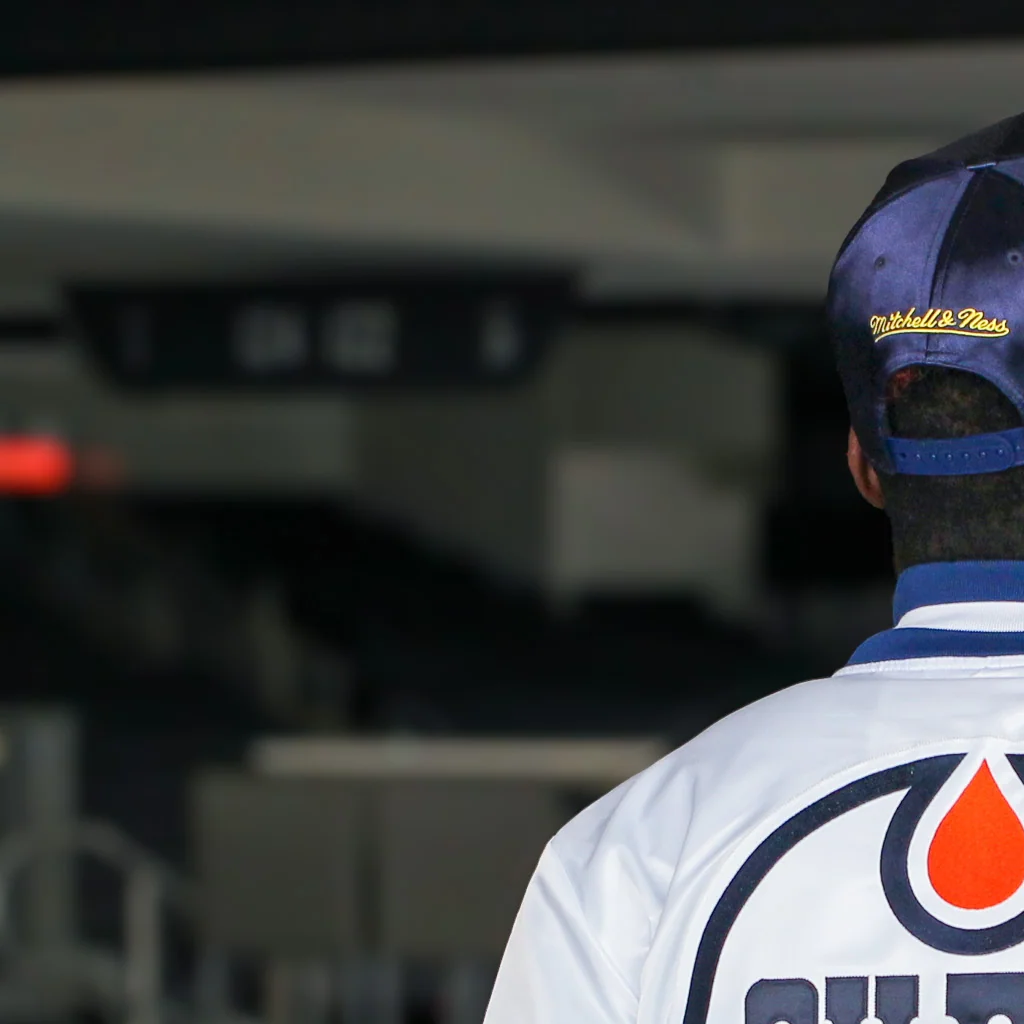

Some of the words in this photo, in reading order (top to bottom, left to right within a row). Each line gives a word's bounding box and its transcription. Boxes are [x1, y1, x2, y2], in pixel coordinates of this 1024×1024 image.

[870, 307, 941, 335] Mitchell
[938, 309, 956, 327] &
[957, 308, 1010, 335] Ness
